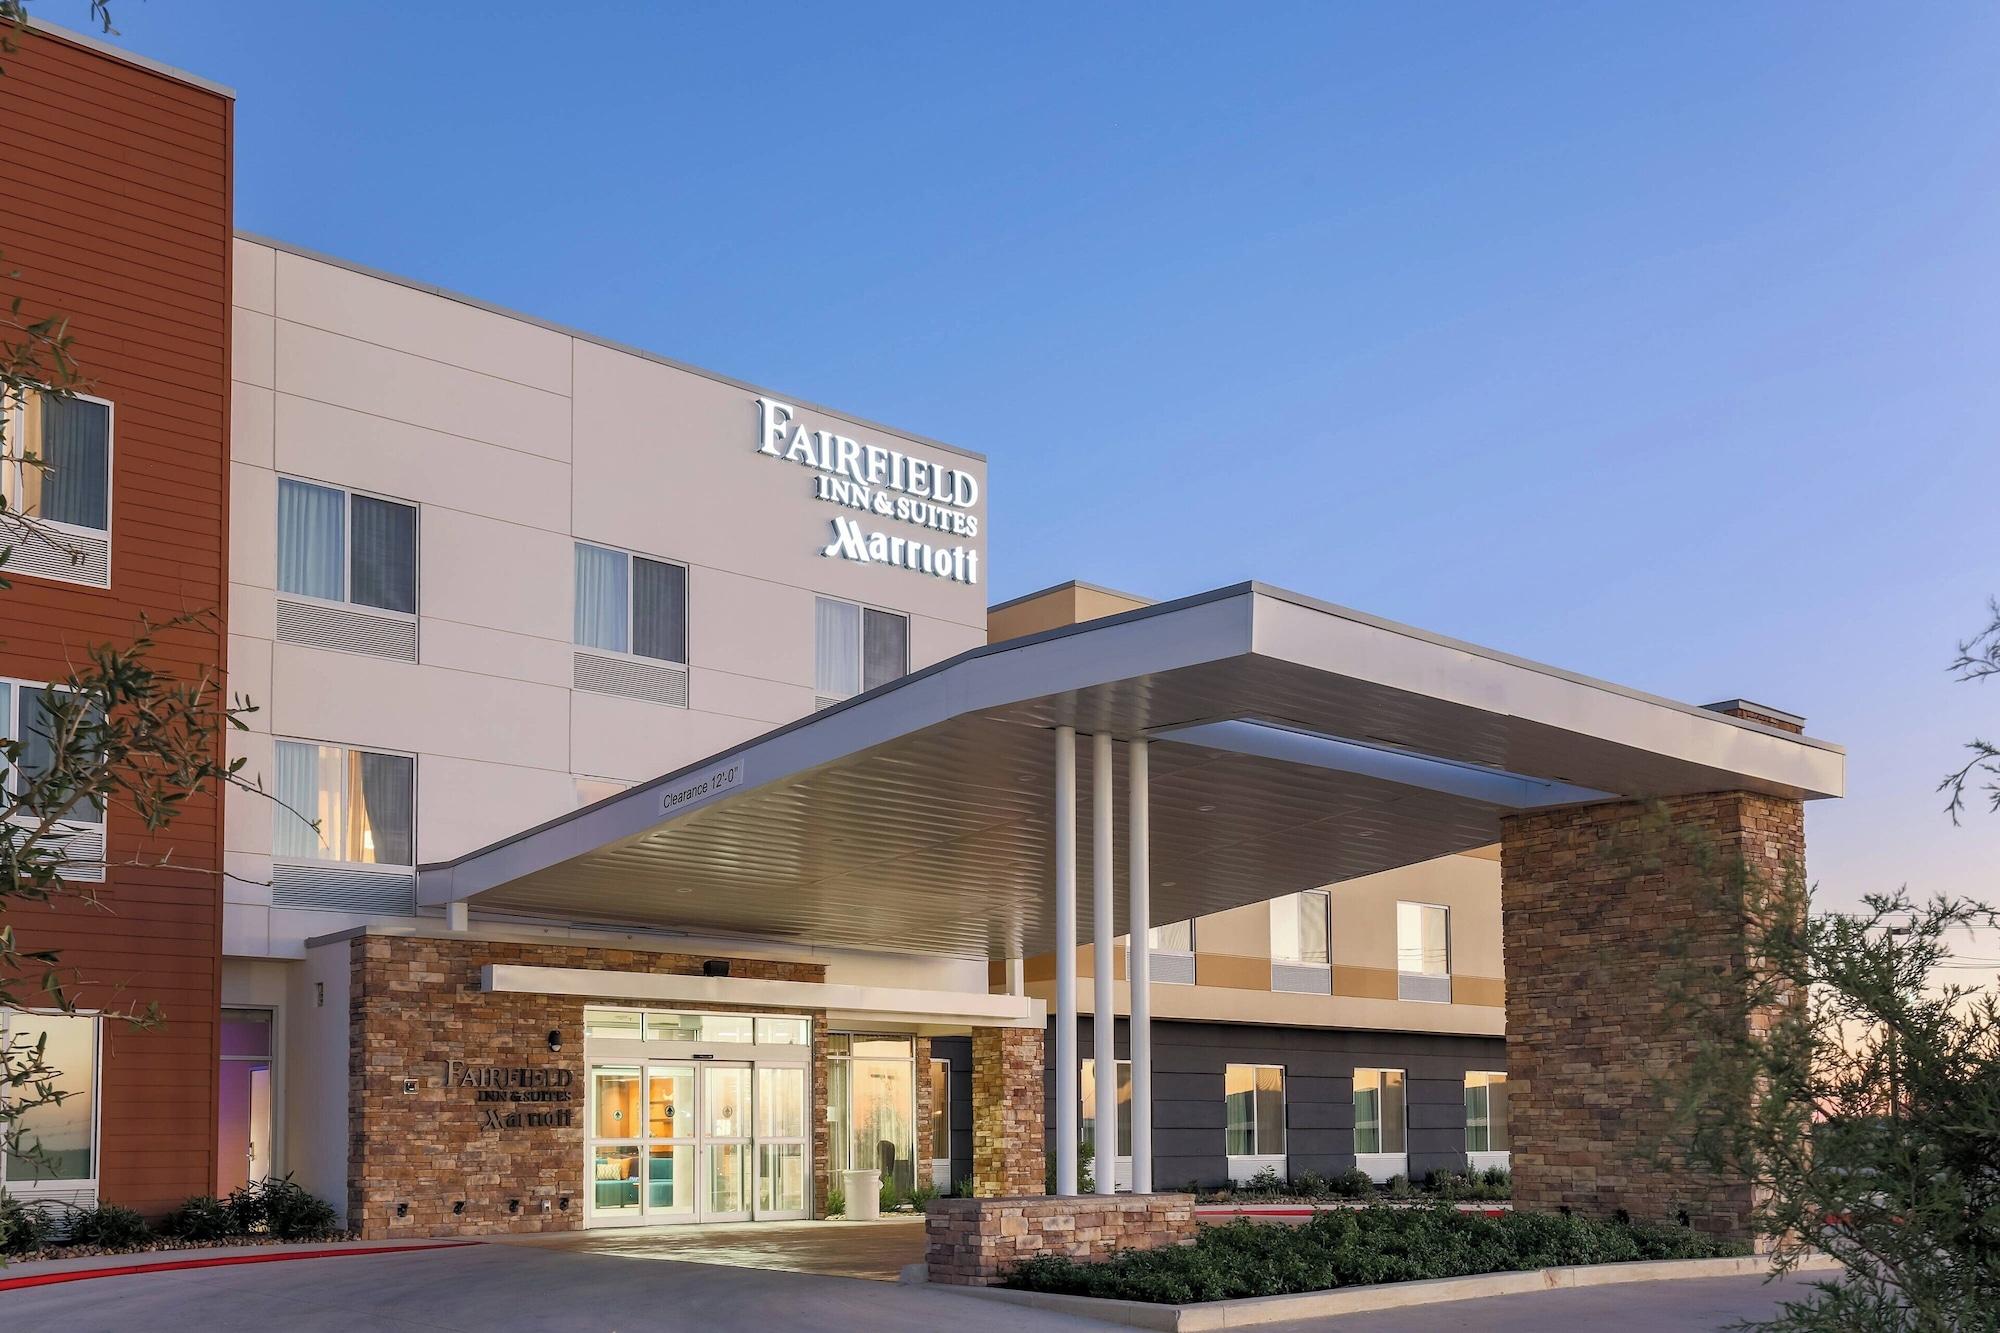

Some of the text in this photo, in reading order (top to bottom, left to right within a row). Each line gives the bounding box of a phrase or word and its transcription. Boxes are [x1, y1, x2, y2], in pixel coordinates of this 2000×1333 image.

[756, 397, 979, 508] FAIRFIELD
[814, 475, 979, 537] INN & SUITES
[820, 516, 979, 584] Marriott
[663, 782, 708, 809] Clearance
[445, 1059, 573, 1090] FAIRFIELD
[478, 1090, 572, 1102] INN & SUITES
[481, 1108, 573, 1132] Marriott
